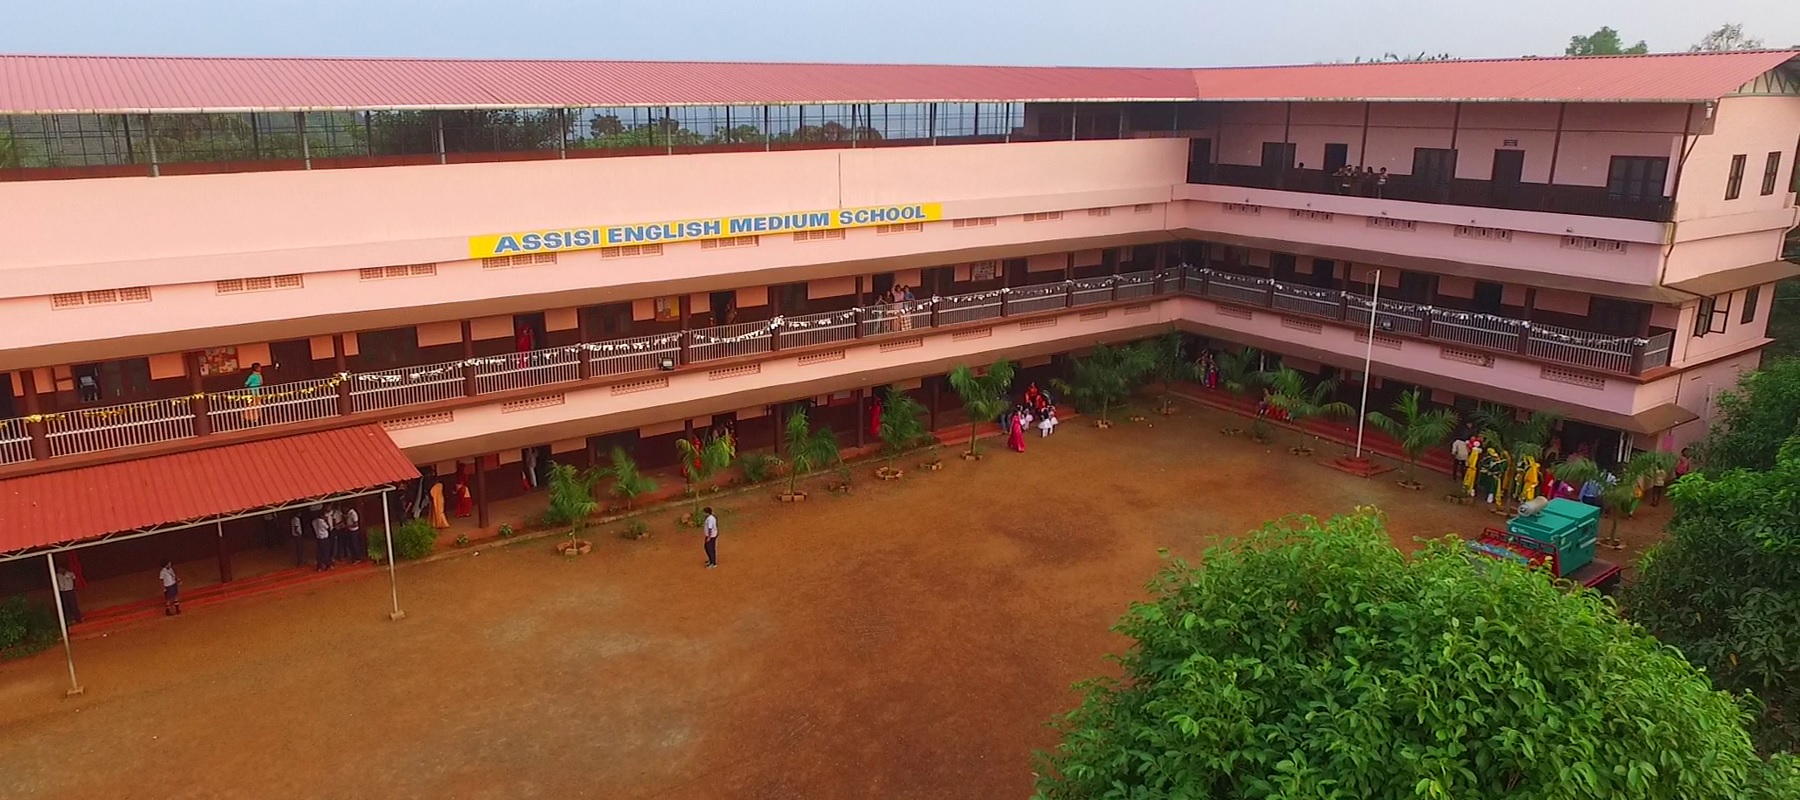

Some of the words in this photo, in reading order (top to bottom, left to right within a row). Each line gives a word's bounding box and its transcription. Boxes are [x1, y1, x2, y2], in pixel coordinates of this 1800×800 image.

[494, 229, 599, 253] ASSISI
[608, 220, 721, 243] ENGLISH
[730, 212, 829, 233] MEDIUM
[839, 206, 926, 225] SCHOOL
